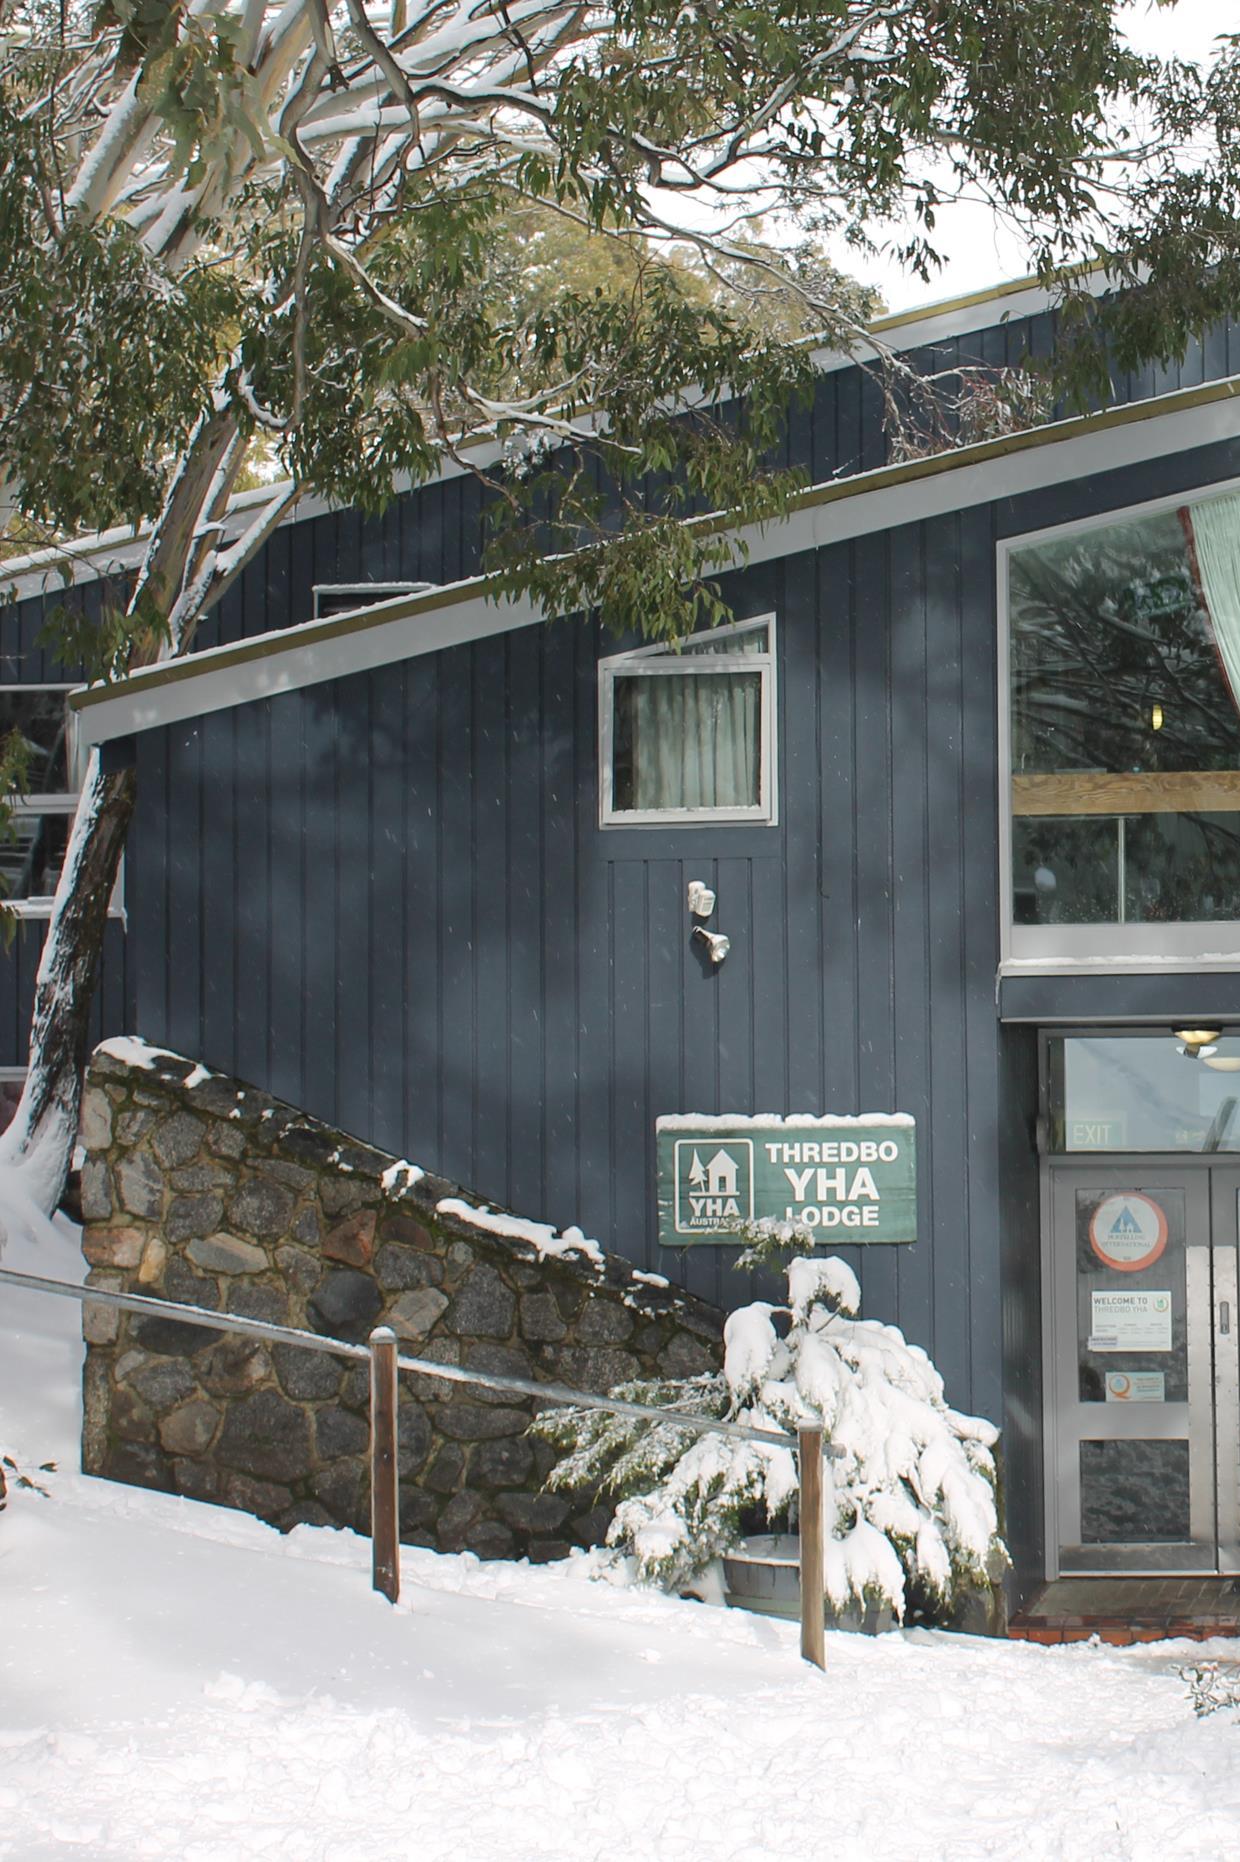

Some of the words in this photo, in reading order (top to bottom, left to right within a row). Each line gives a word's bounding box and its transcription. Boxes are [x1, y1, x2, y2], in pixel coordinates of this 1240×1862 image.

[1073, 1124, 1112, 1144] EXIT
[765, 1141, 898, 1164] THREDBO
[783, 1167, 880, 1202] YHA
[689, 1198, 740, 1217] YHA
[785, 1206, 880, 1227] LODGE
[1093, 1297, 1135, 1305] WELCOME
